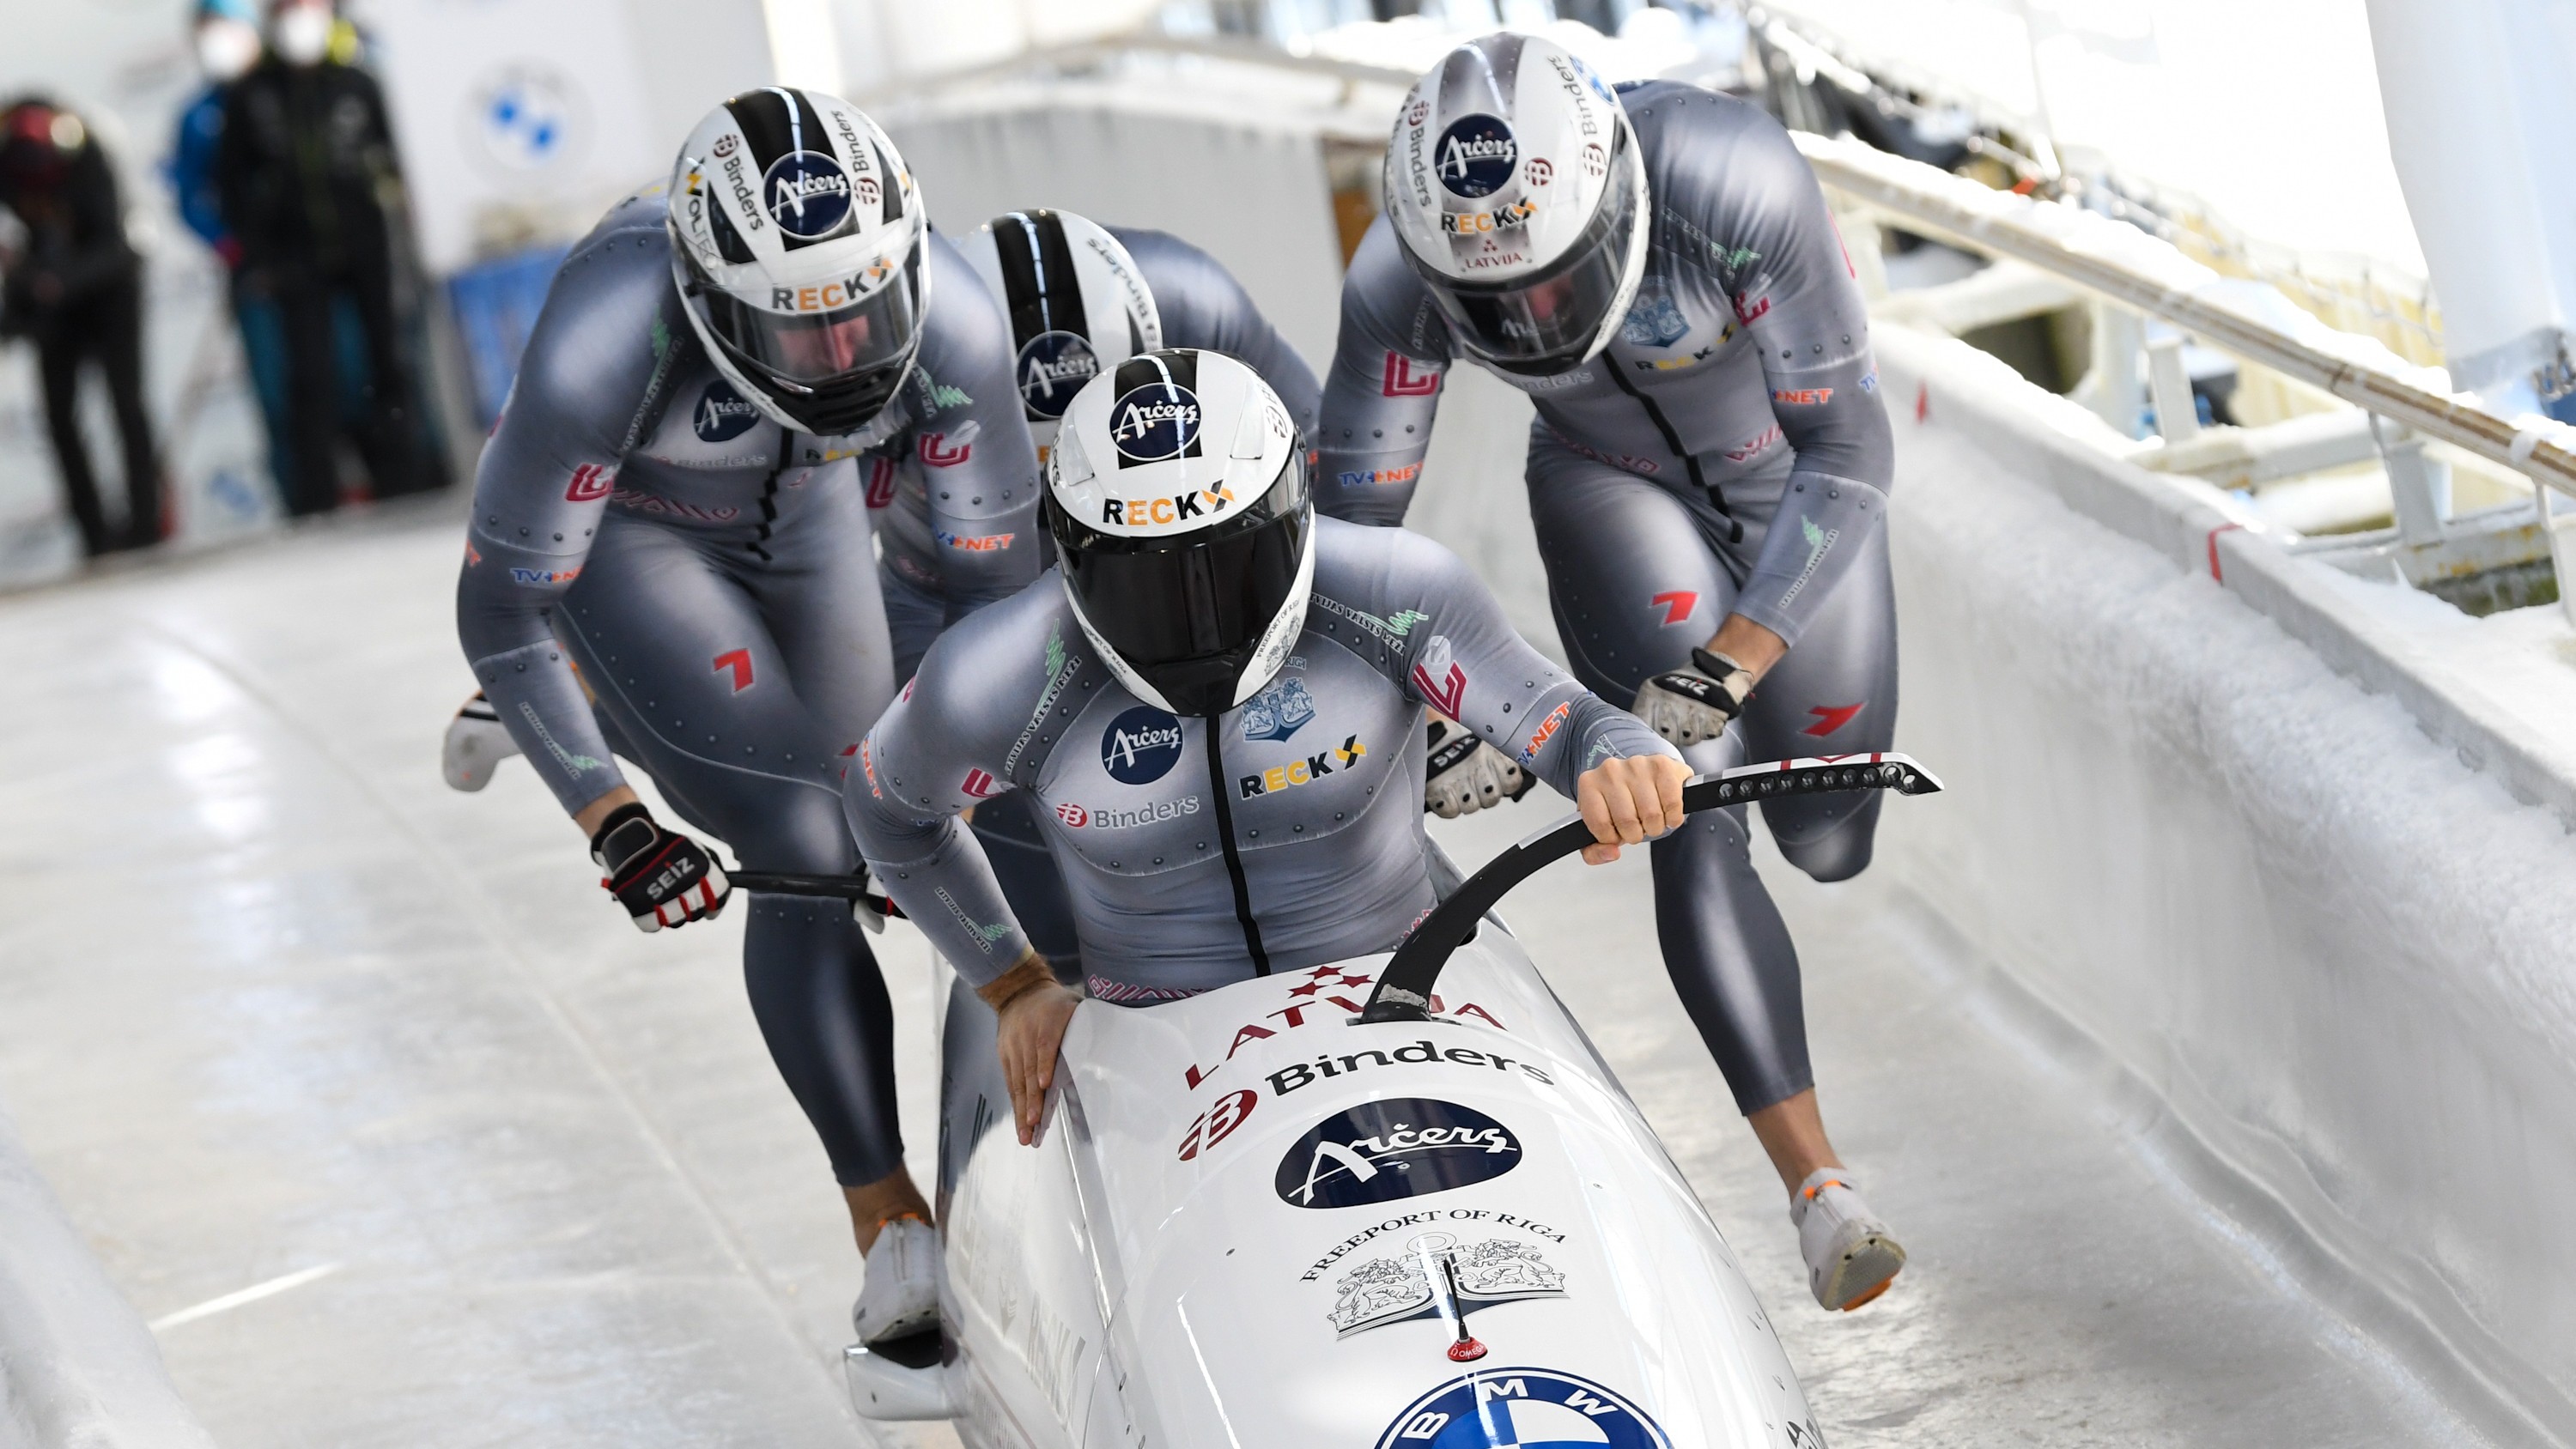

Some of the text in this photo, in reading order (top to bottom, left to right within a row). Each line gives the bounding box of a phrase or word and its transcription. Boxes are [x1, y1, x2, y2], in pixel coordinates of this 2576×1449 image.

[1546, 55, 1598, 137] Binders
[832, 110, 869, 173] Binders
[1409, 126, 1432, 207] Binders
[723, 155, 764, 232] Binders
[1465, 252, 1523, 270] LATVIJA
[1309, 592, 1345, 615] TVIJAS
[1345, 607, 1382, 637] VALSTS
[1026, 687, 1060, 732] VALSTS
[1056, 655, 1083, 689] MEŽI
[1092, 795, 1200, 829] Binders
[1264, 1040, 1555, 1097] Binders
[1299, 1208, 1568, 1283] FREEPORT OF RIGA
[1400, 1377, 1619, 1441] BMW
